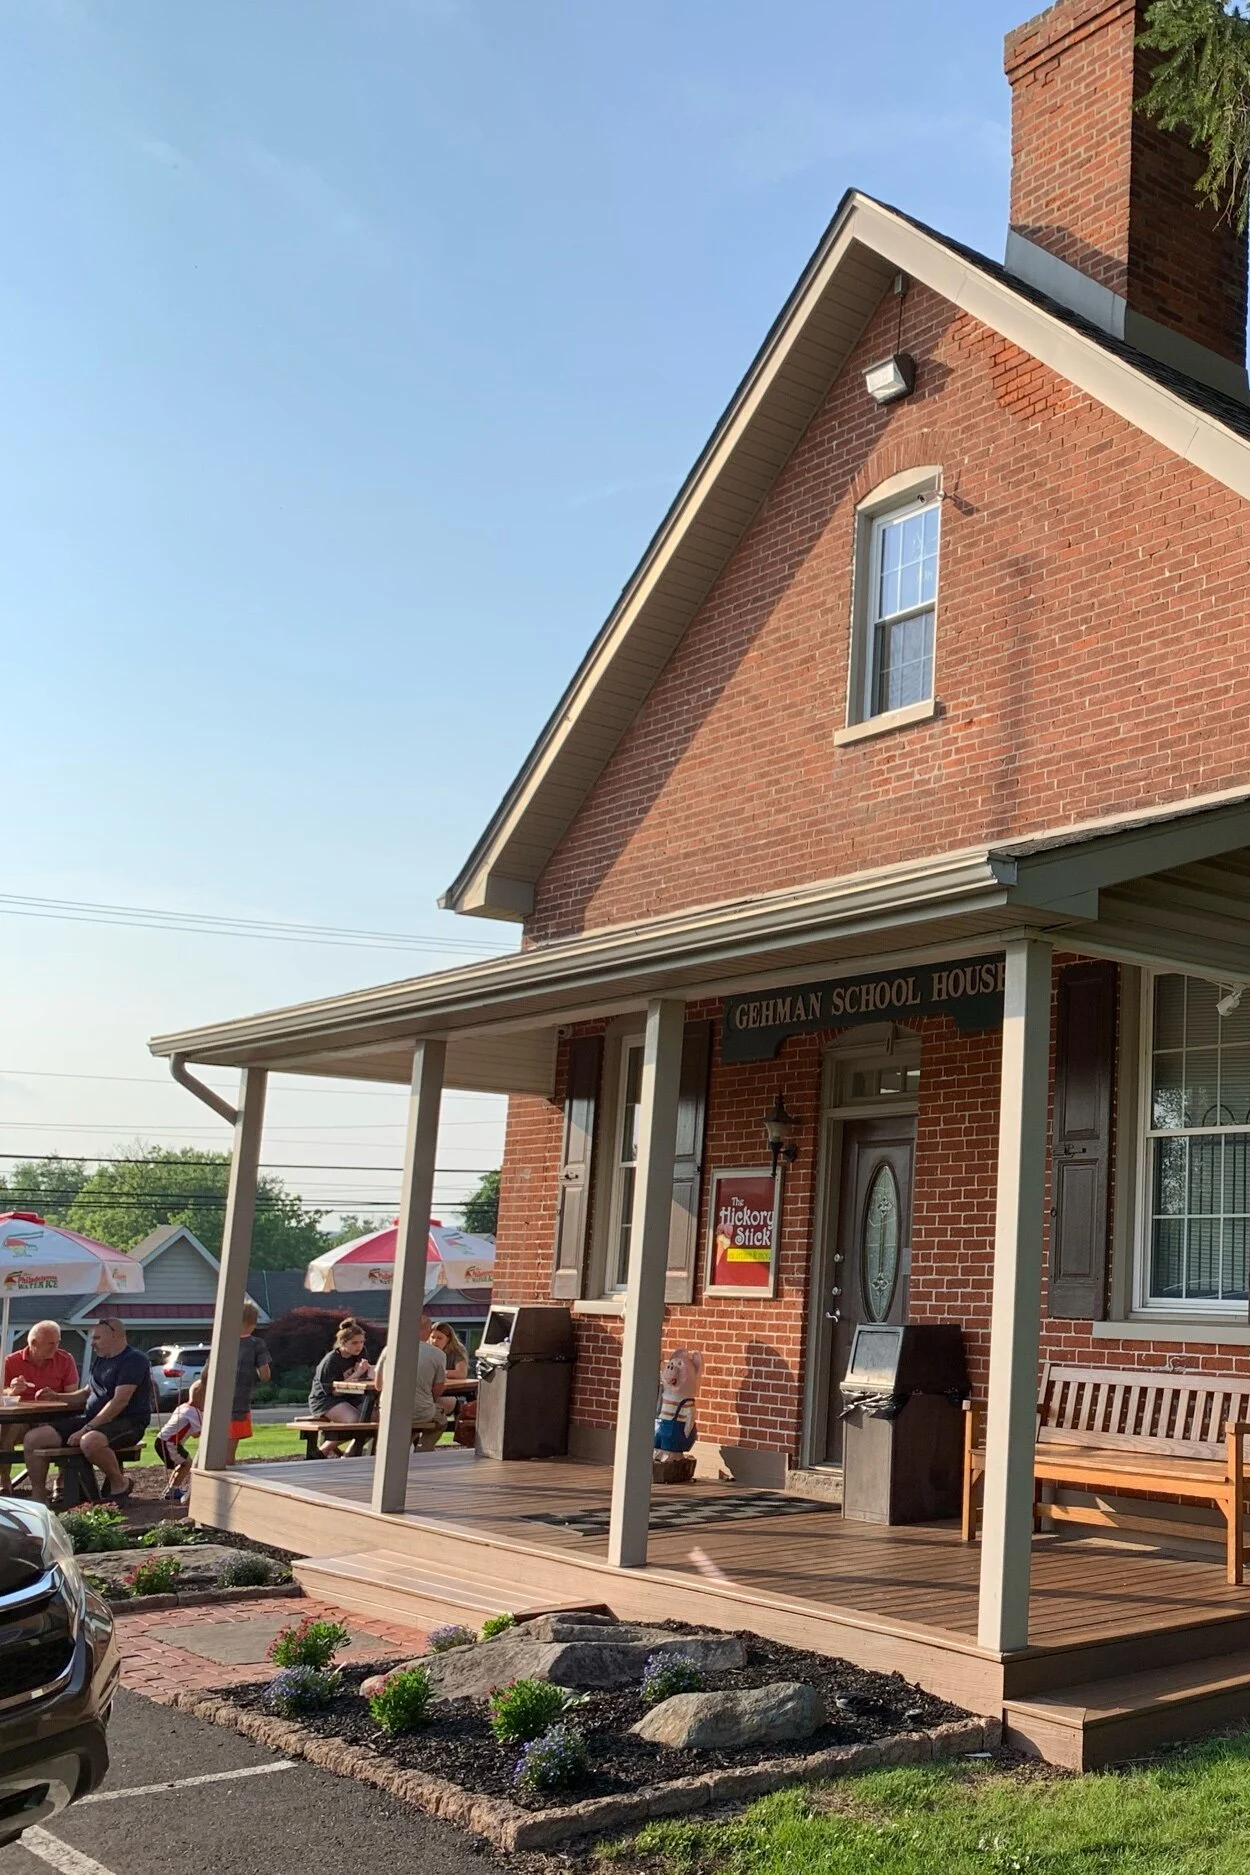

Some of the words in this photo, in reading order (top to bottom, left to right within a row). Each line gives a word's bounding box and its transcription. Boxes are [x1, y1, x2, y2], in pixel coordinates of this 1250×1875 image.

[735, 991, 822, 1030] GEHMAN
[831, 976, 921, 1016] SCHOOL
[731, 1196, 745, 1206] The
[719, 1206, 774, 1230] Hickory
[734, 1227, 771, 1246] Stick
